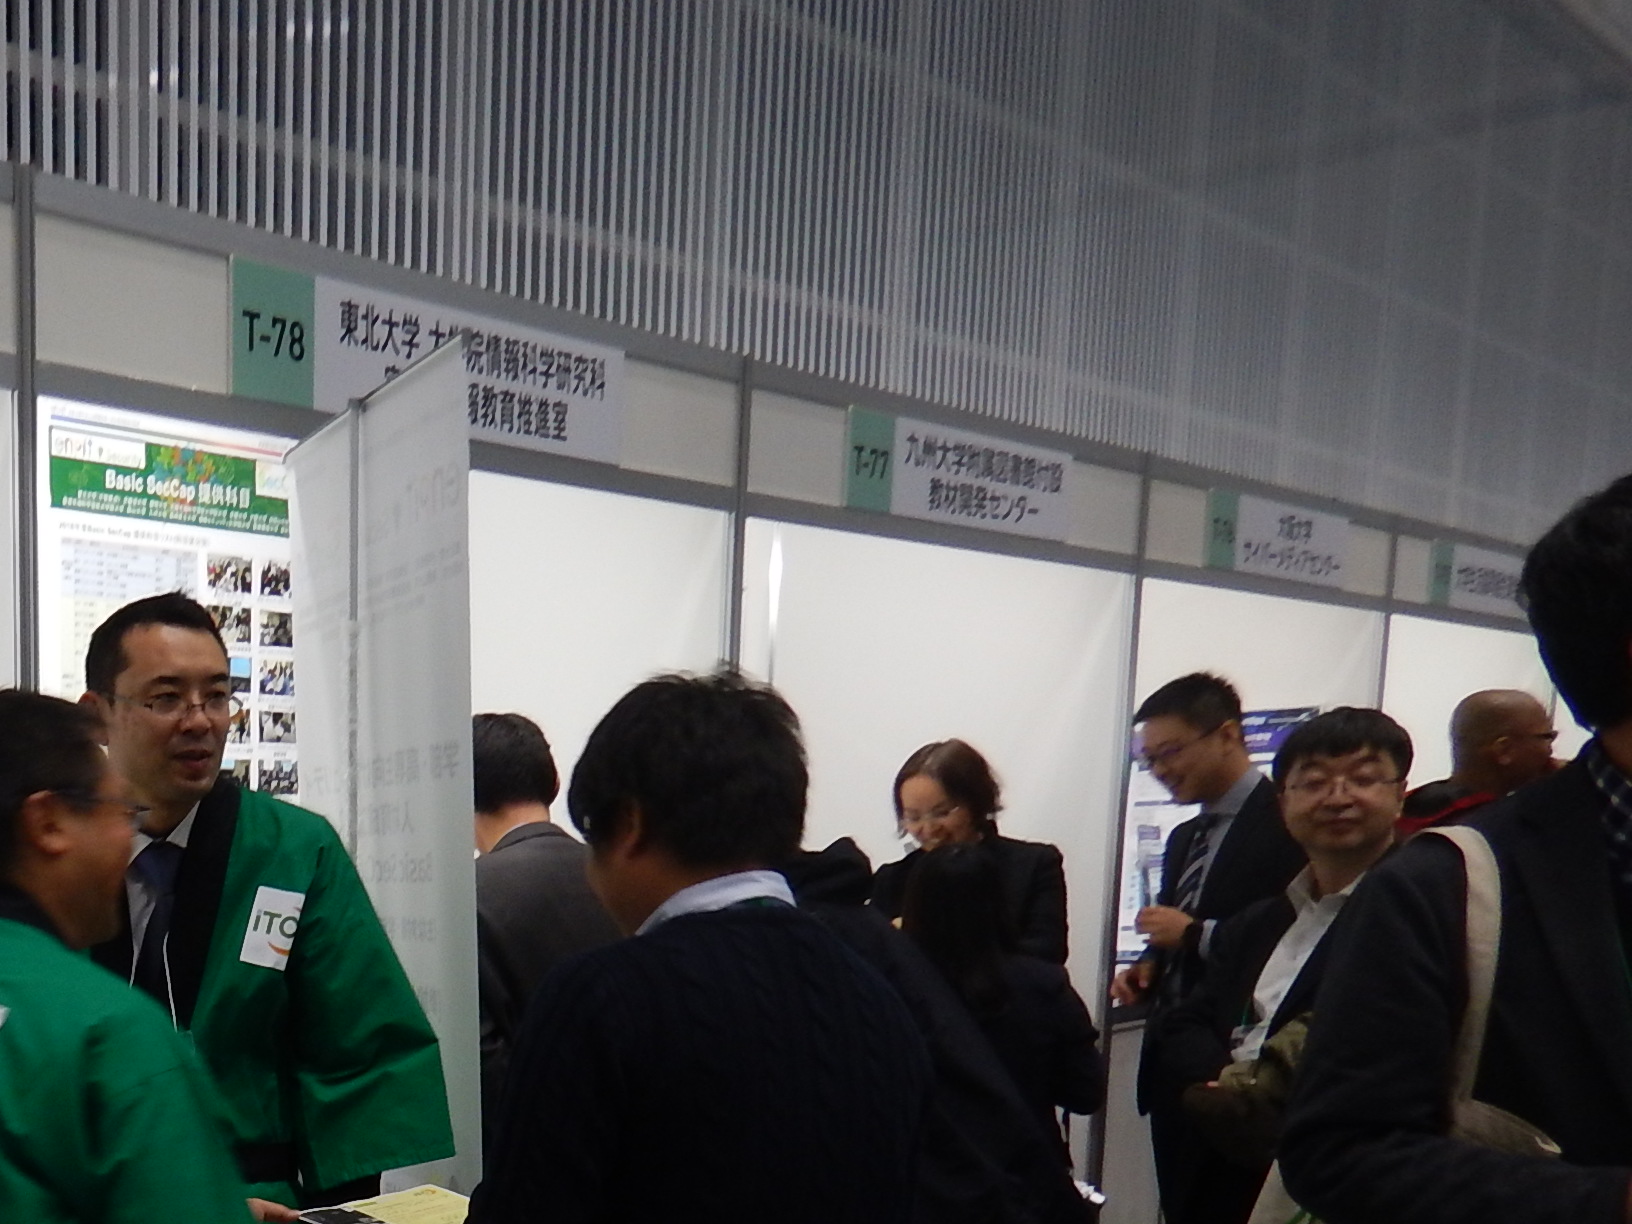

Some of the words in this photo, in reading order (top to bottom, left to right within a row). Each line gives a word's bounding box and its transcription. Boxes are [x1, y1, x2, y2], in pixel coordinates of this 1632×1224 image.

[242, 310, 306, 362] T-78
[338, 300, 421, 360] 東北大学
[853, 445, 889, 480] T-77
[105, 469, 144, 494] Basic
[146, 474, 197, 504] SecCap
